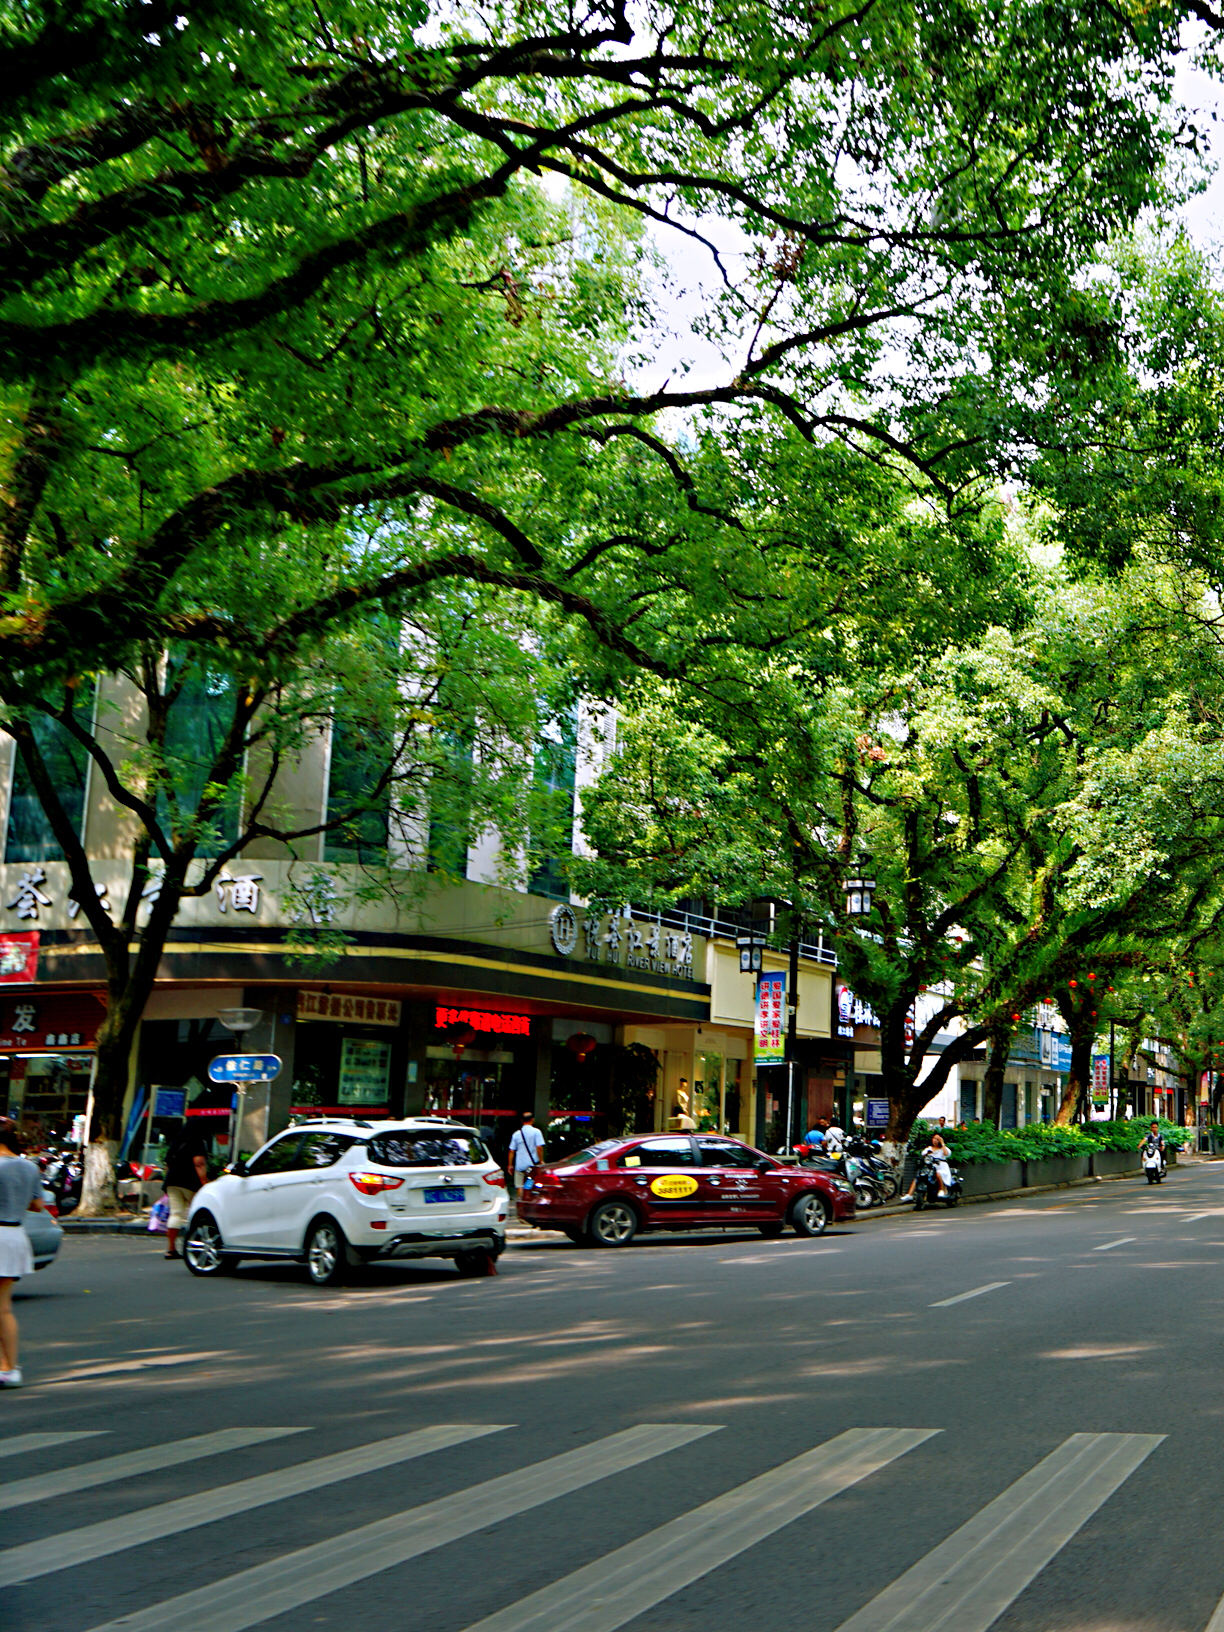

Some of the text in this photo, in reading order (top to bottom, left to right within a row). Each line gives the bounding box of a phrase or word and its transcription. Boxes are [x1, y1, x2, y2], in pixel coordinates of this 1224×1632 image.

[627, 953, 650, 970] RIVER
[651, 959, 670, 974] VIEW
[671, 964, 694, 980] HOTEL
